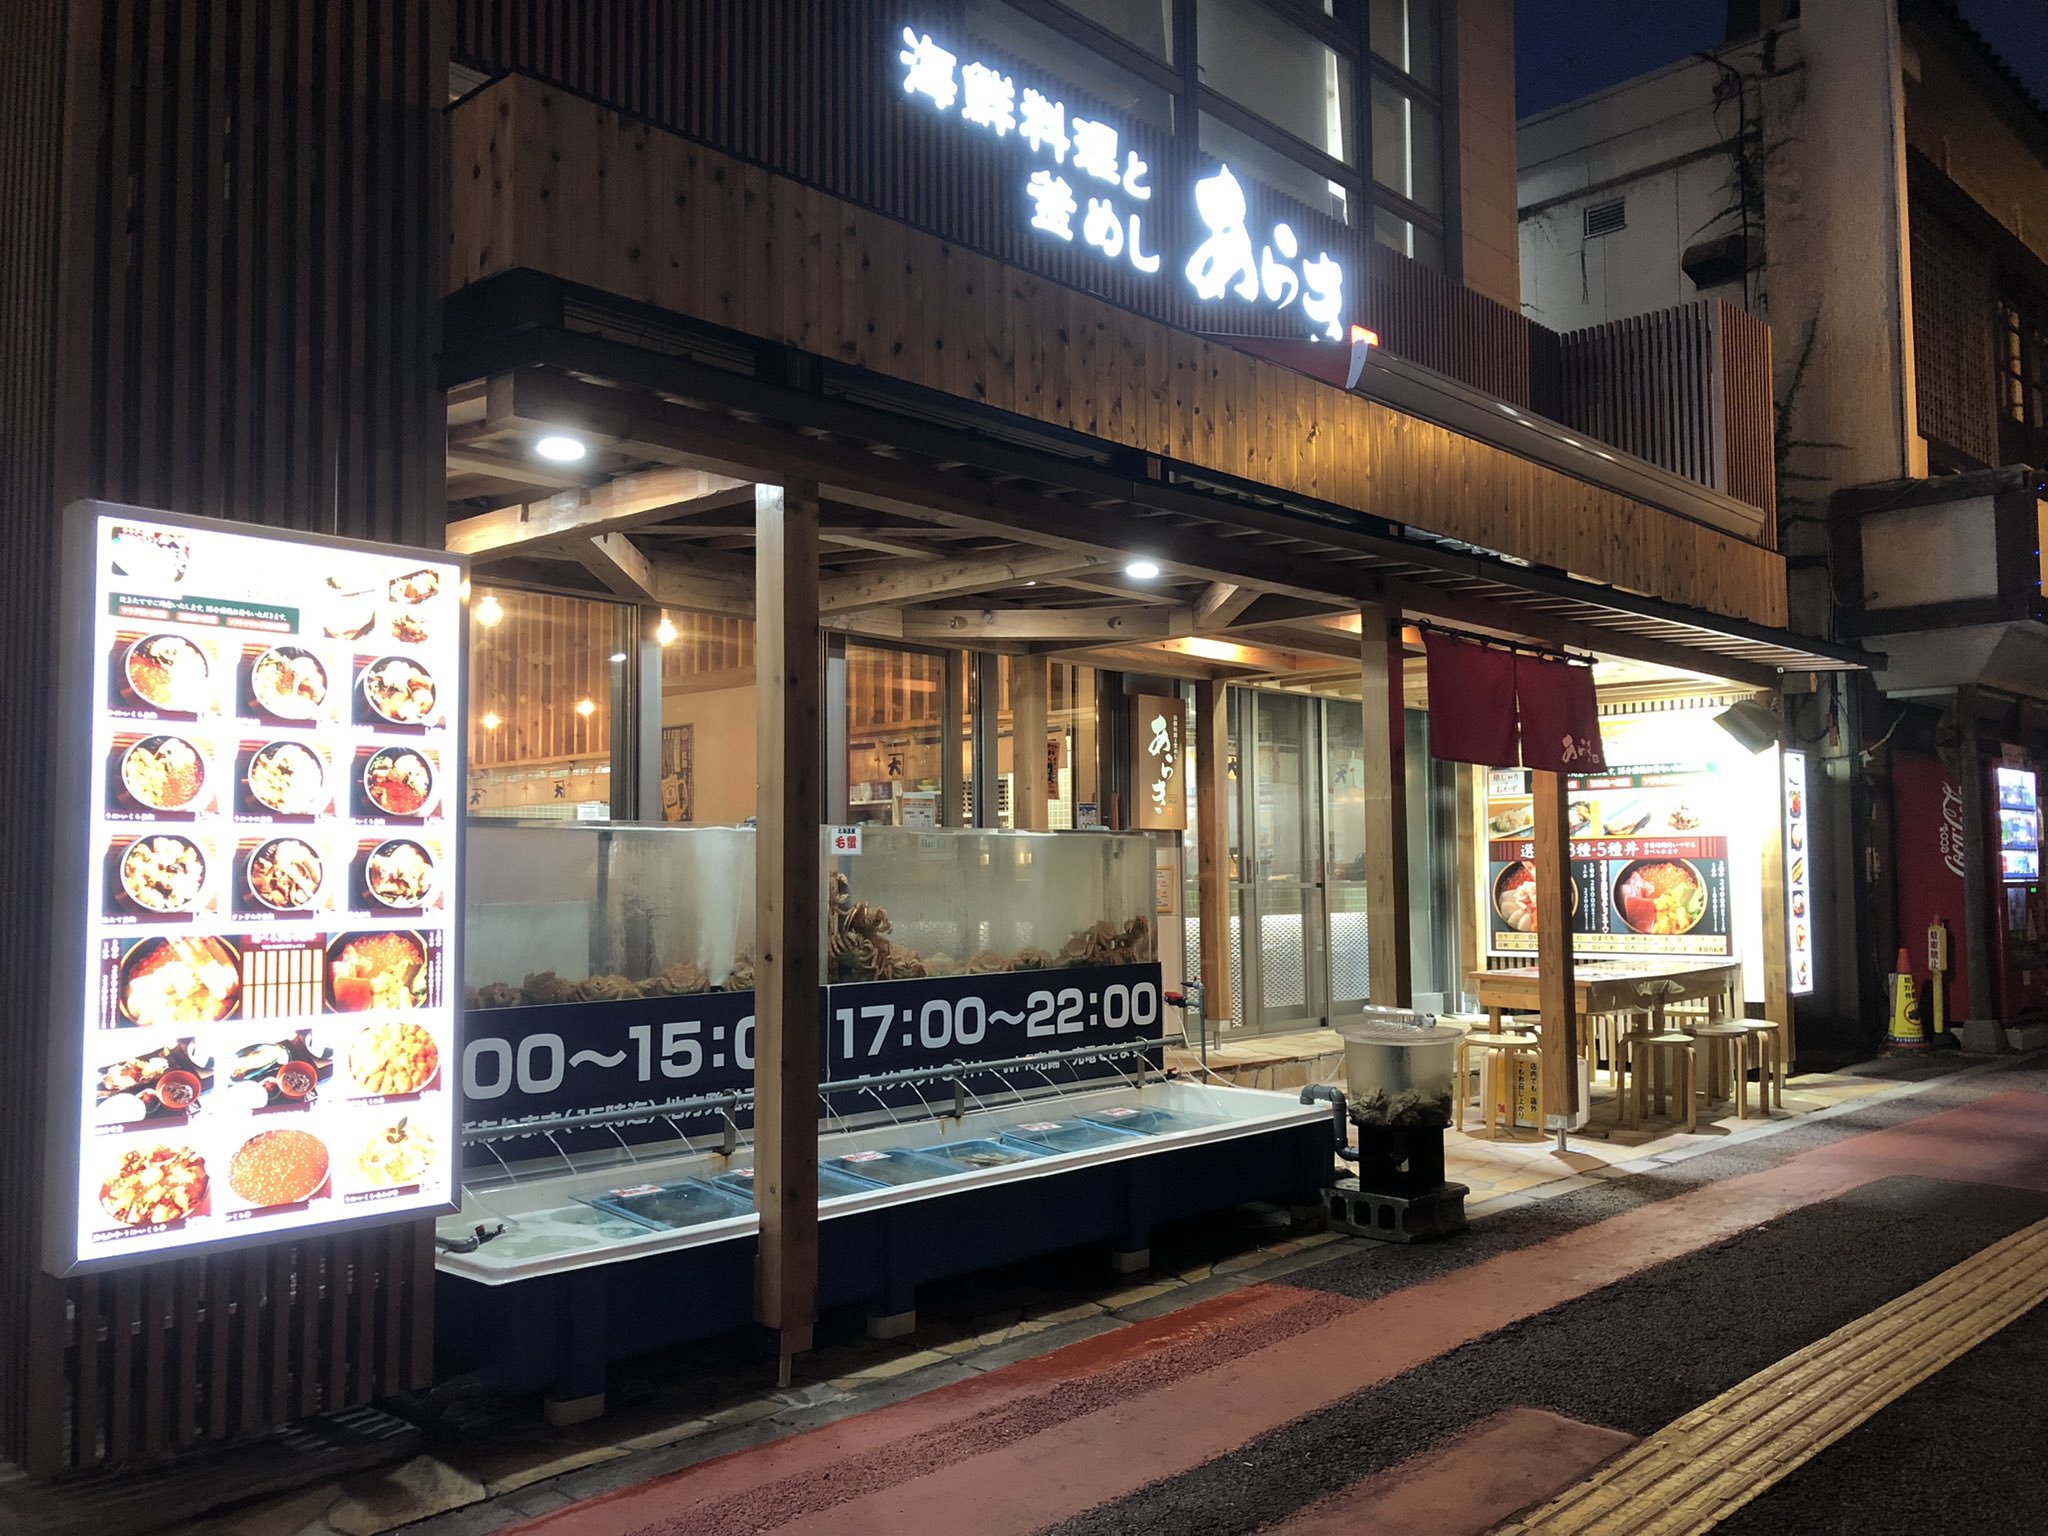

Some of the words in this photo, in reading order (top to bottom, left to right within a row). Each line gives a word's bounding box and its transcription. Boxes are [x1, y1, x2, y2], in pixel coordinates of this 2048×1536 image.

[900, 27, 1151, 200] 海鮮料理と
[1026, 170, 1160, 273] 釜めし
[1185, 163, 1343, 342] あらき
[1148, 713, 1174, 815] あらき
[835, 835, 856, 849] 毛蟹
[1930, 930, 1938, 969] 駐車禁止
